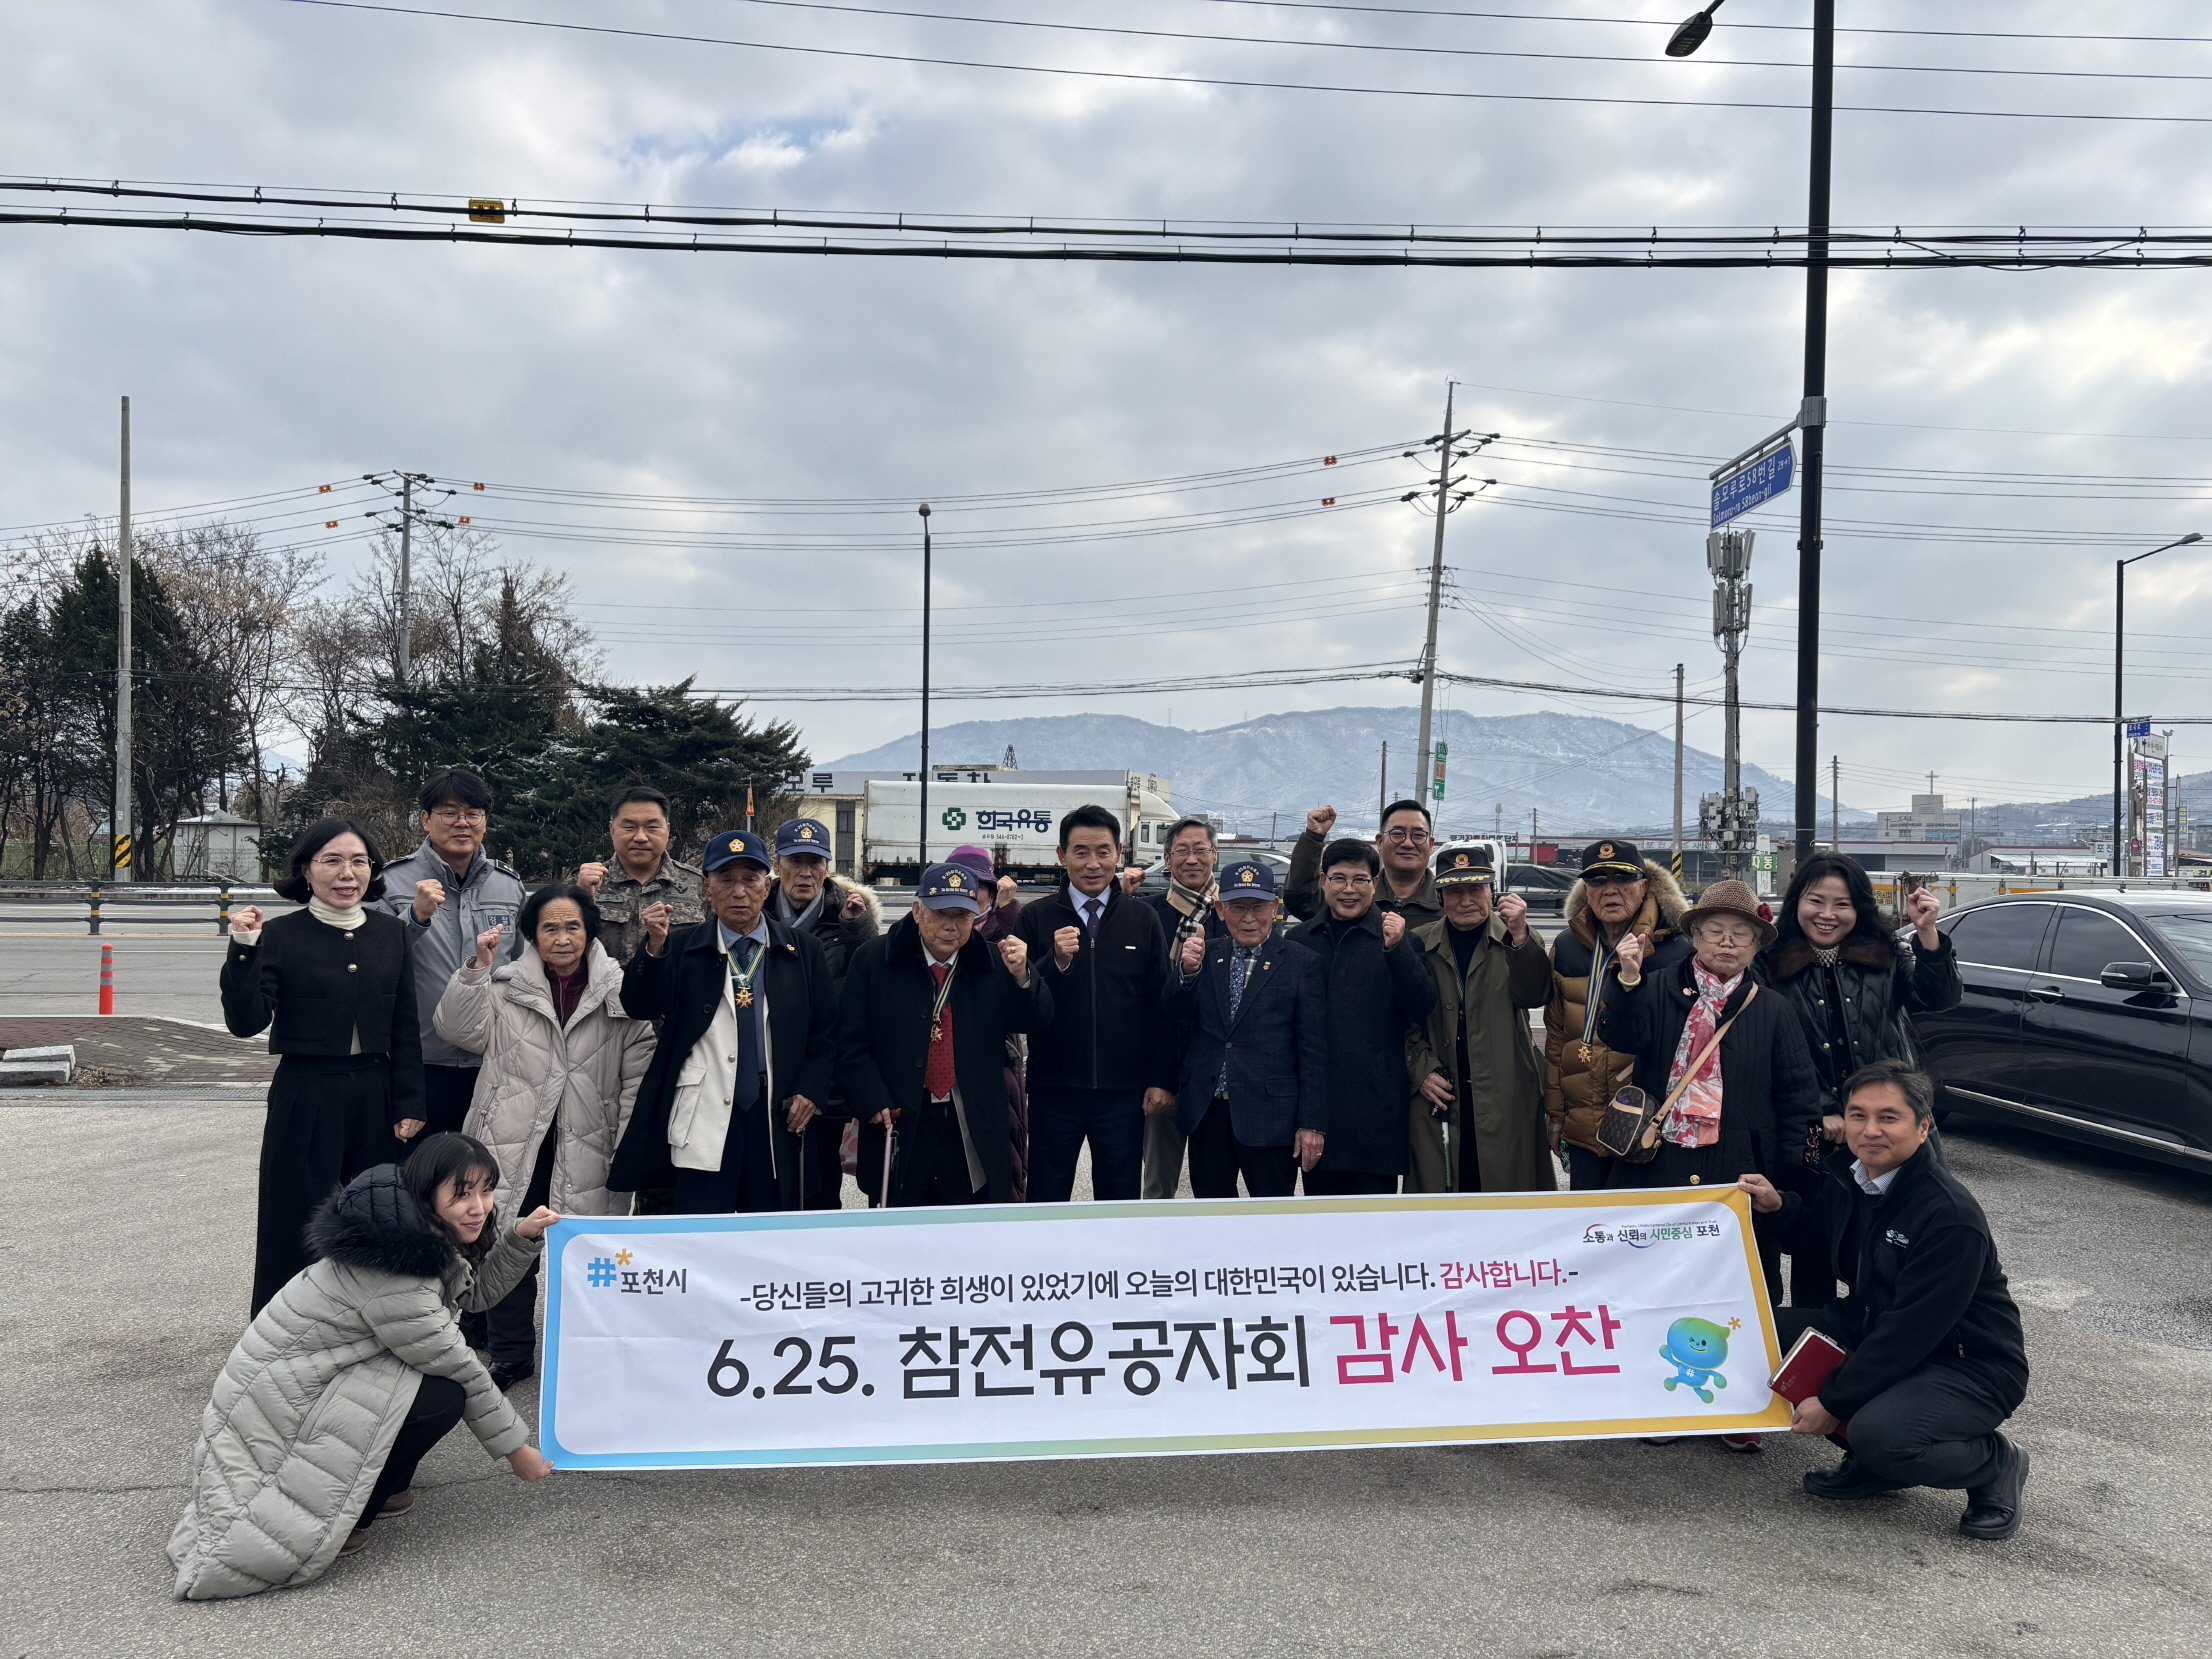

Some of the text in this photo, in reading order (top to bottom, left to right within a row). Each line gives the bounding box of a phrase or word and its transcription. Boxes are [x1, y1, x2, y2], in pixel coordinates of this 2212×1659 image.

[1713, 456, 1775, 511] 솔모루로58번길
[1742, 482, 1772, 509] 58beon-gil
[976, 809, 1053, 833] 한국유통
[1583, 1223, 1721, 1243] 소통과 신뢰의 시민중심 포천
[620, 1268, 687, 1295] 포천시
[858, 1276, 935, 1307] 고귀한
[940, 1273, 1014, 1305] 희생이
[1020, 1270, 1119, 1302] 있었기에
[1125, 1268, 1198, 1298] 오늘의
[1204, 1264, 1325, 1297] 대한민국이
[1331, 1262, 1436, 1293] 있습니다.
[706, 1304, 1622, 1400] 6.25. 참전유공자회 감사 오찬
